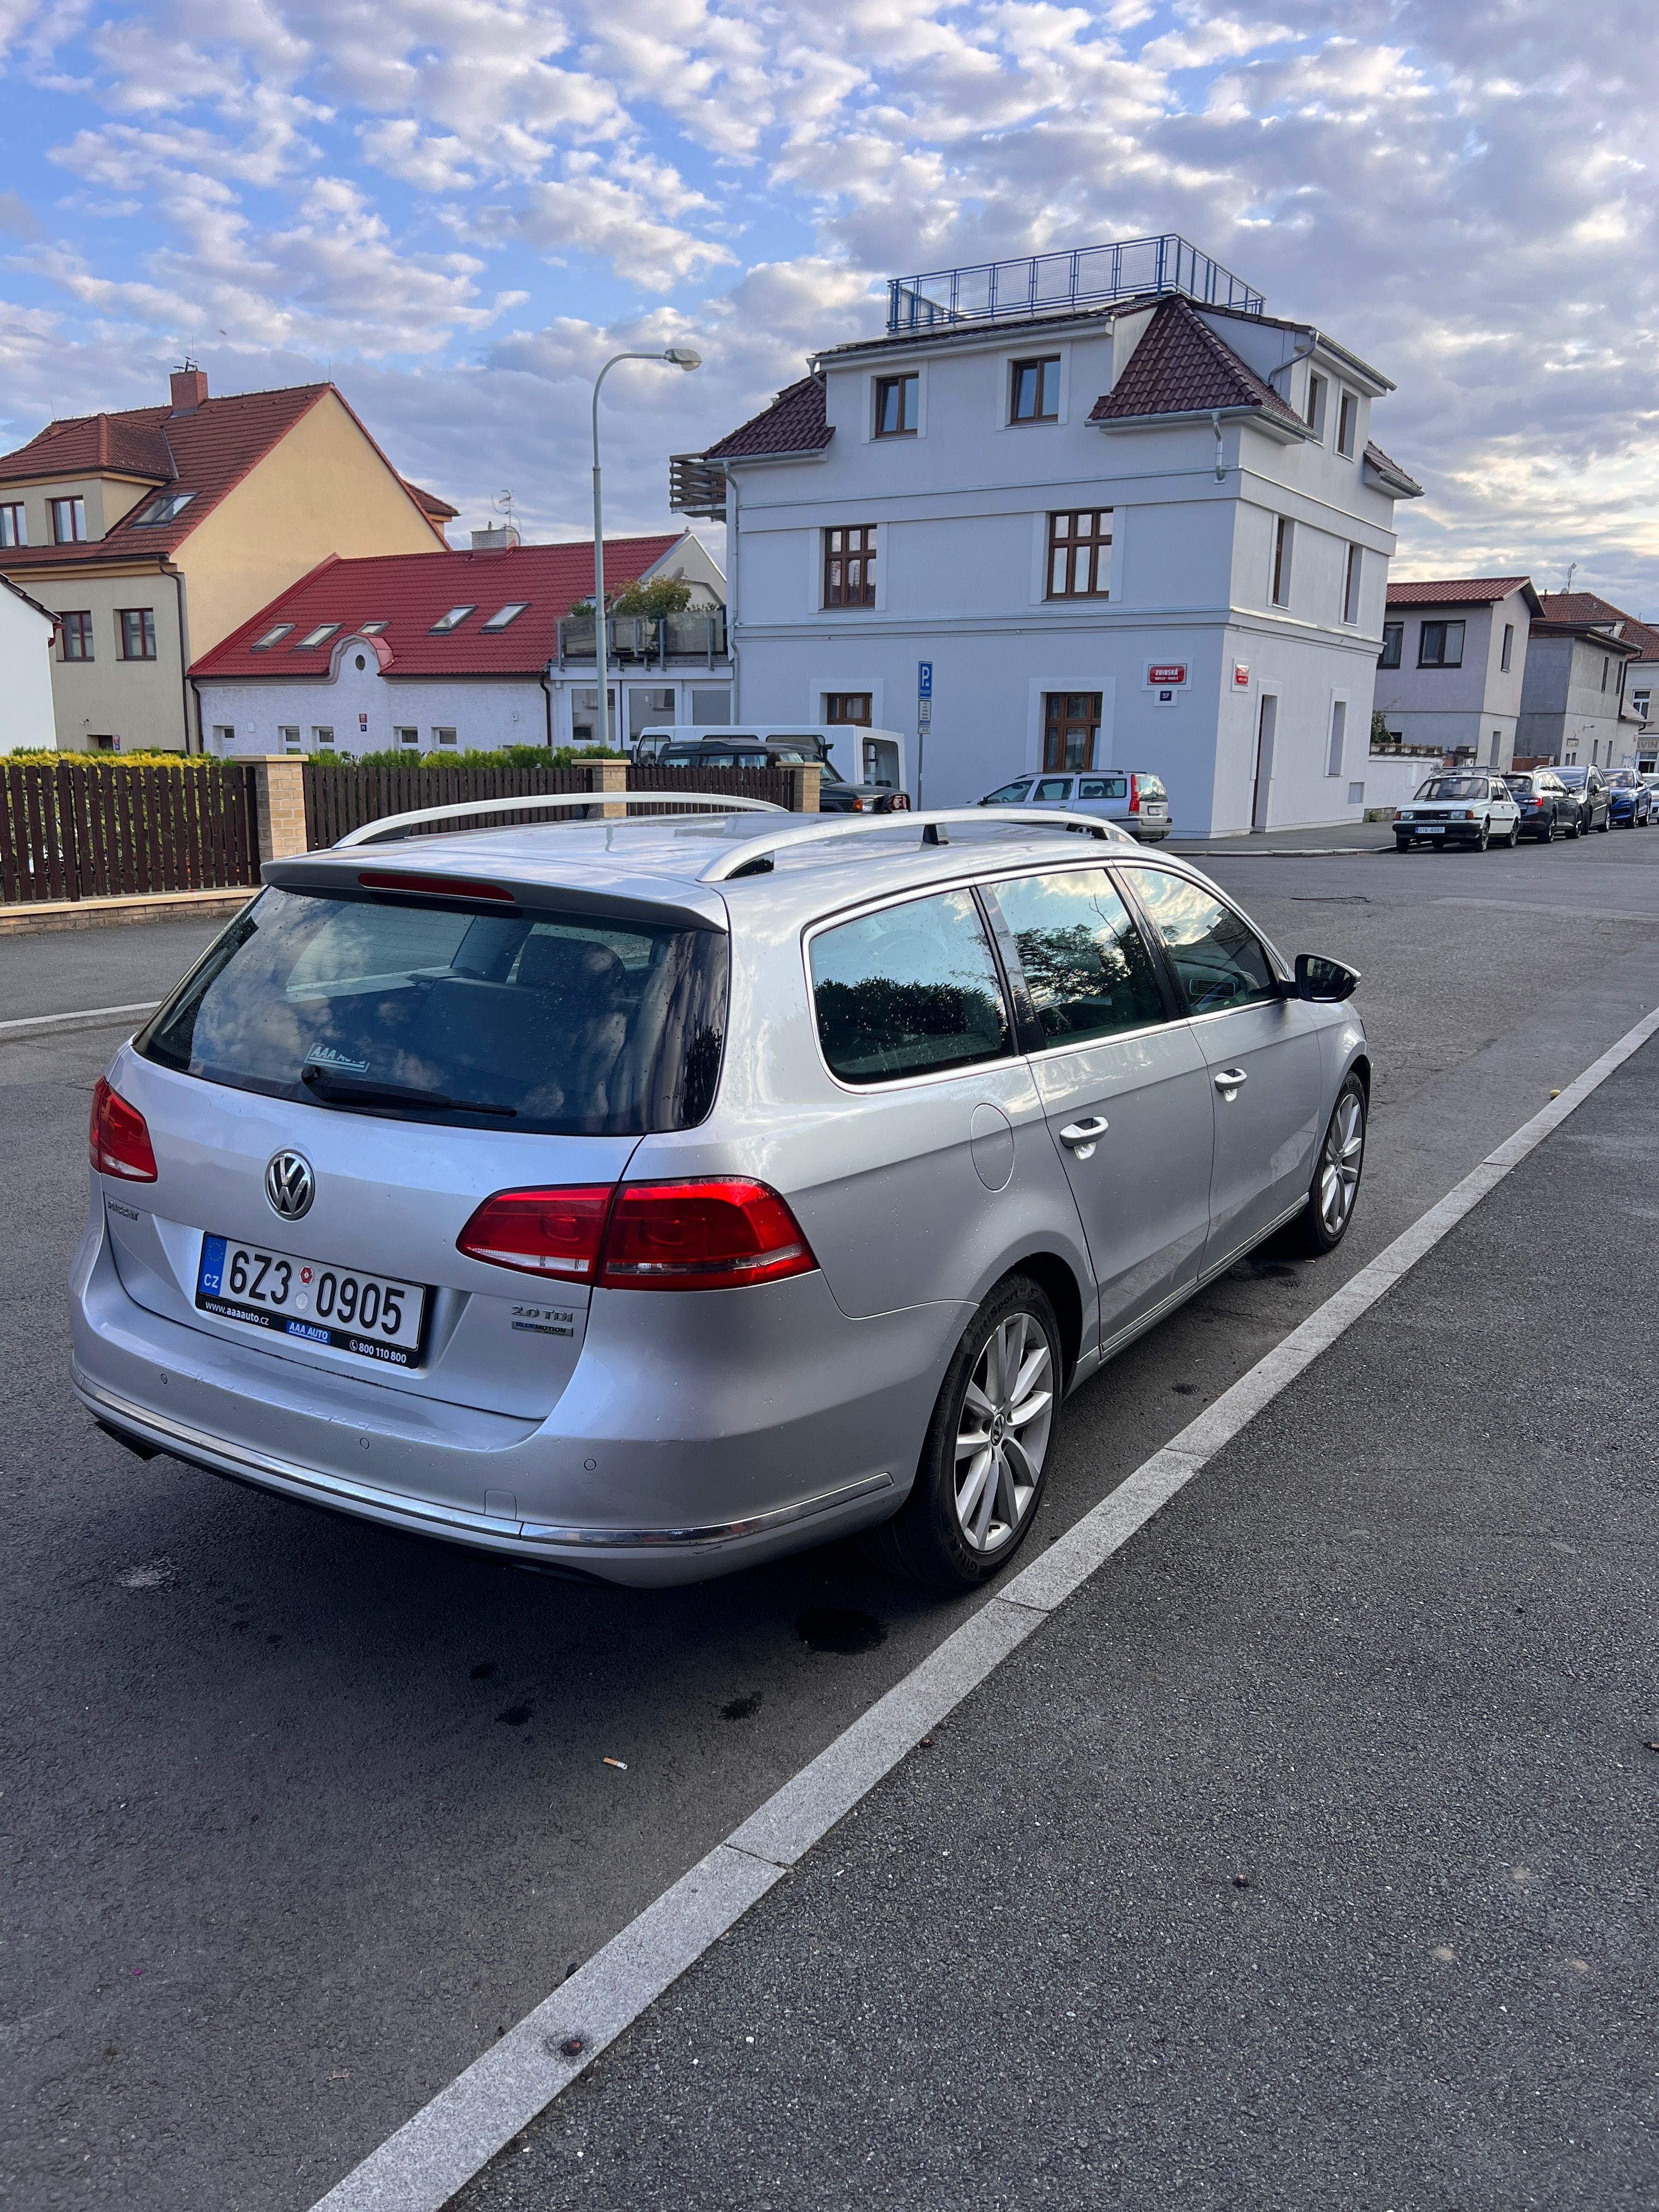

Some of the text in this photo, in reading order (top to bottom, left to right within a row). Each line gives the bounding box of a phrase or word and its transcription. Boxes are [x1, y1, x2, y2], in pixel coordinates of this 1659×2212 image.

[921, 666, 930, 687] P
[311, 1046, 337, 1060] AAA
[204, 1273, 219, 1289] CZ
[229, 1250, 405, 1335] 6Z3 0905
[205, 1301, 269, 1325] www.aaaauto.cz
[541, 1309, 573, 1323] TDI
[289, 1322, 328, 1340] AAA AUTO
[359, 1342, 407, 1363] 800 110 800
